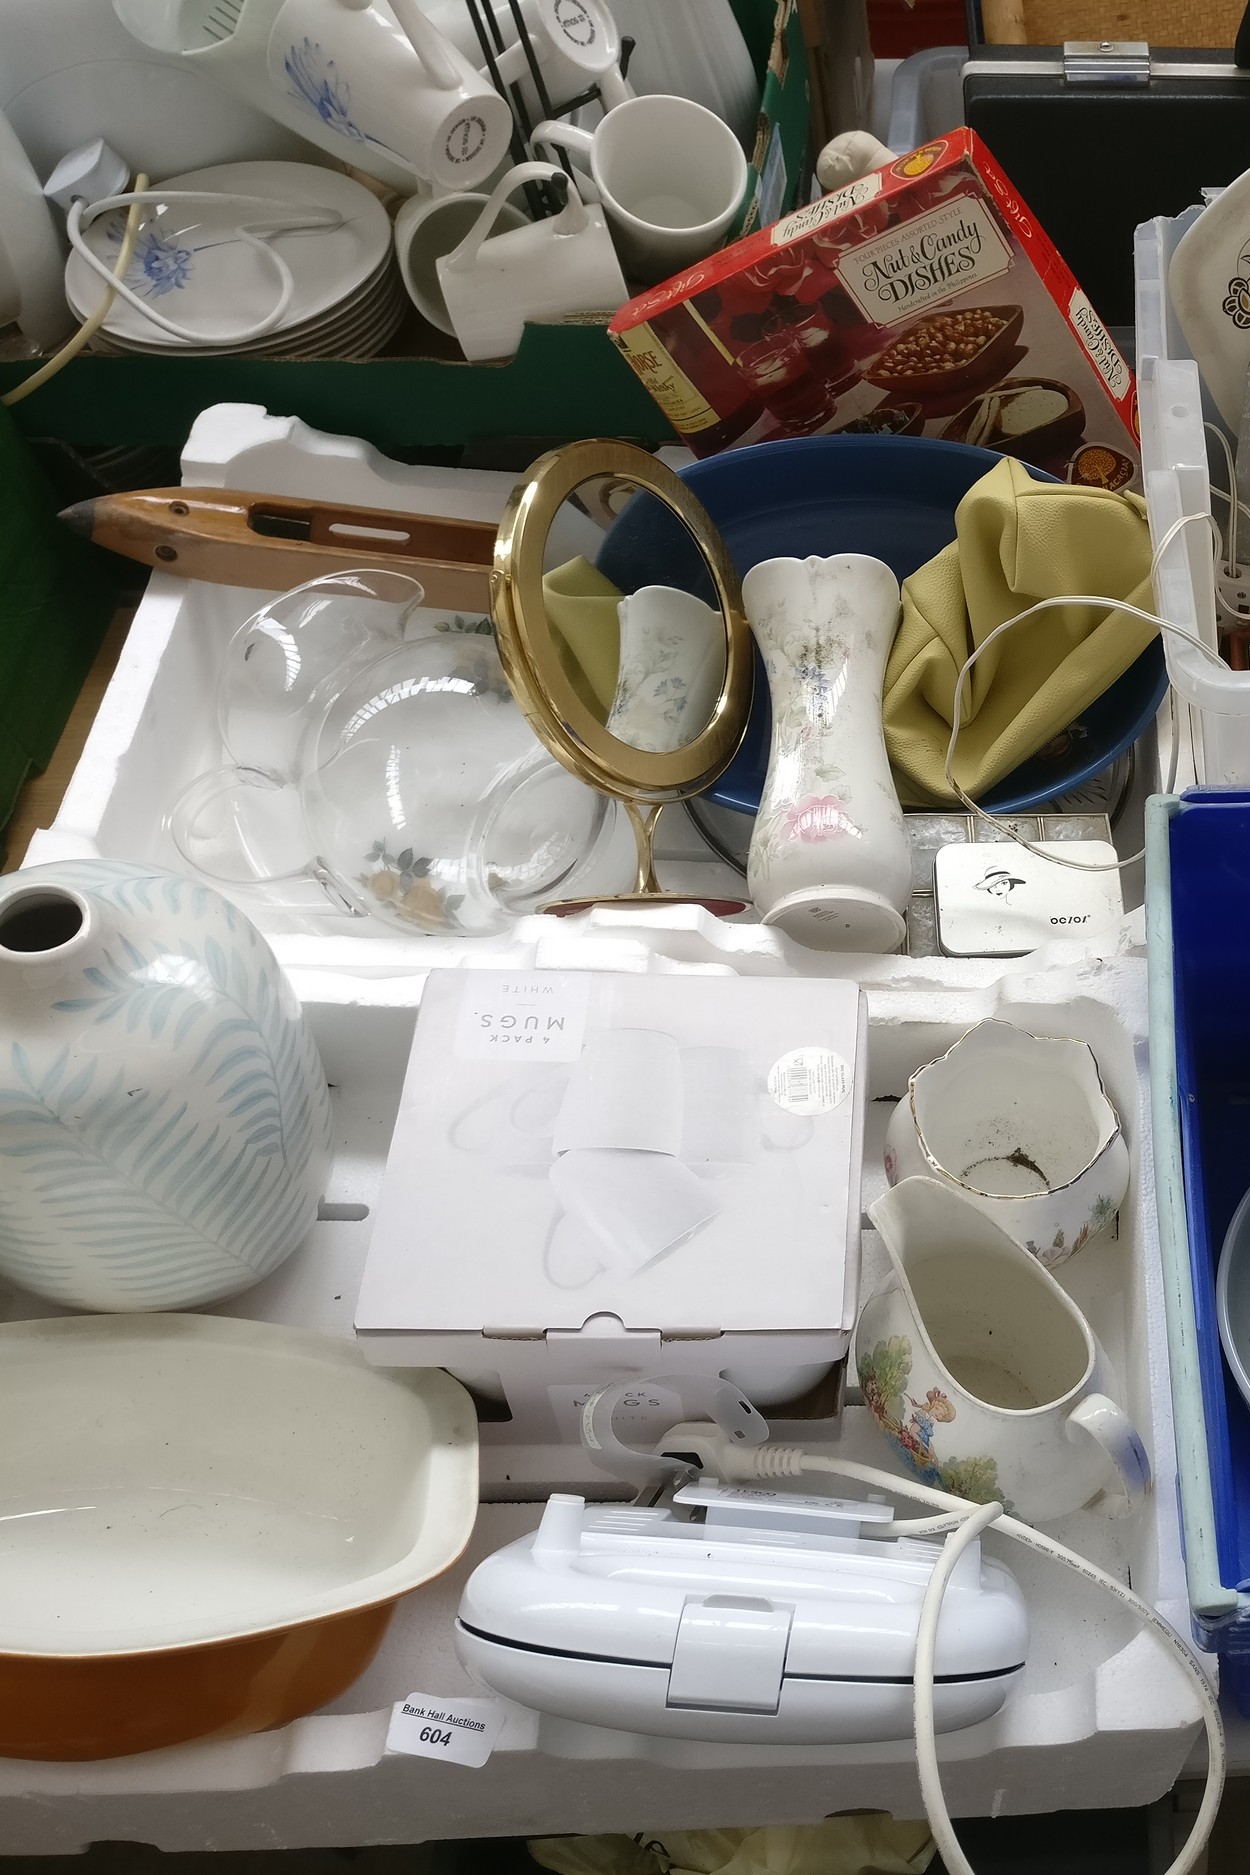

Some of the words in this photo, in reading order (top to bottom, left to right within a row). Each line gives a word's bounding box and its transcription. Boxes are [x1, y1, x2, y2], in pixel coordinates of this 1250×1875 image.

[876, 238, 901, 255] PIECES
[901, 220, 938, 243] ASSORTED
[938, 206, 963, 226] STYLE
[862, 248, 911, 292] Nut
[919, 219, 988, 261] Candy
[877, 246, 977, 304] DISHES
[500, 984, 556, 995] WHITE
[488, 1034, 534, 1044] PACK
[542, 1036, 551, 1044] 4
[402, 1703, 425, 1717] Bank
[427, 1709, 446, 1721] Hall
[446, 1714, 486, 1731] Auctions
[419, 1726, 452, 1747] 604
